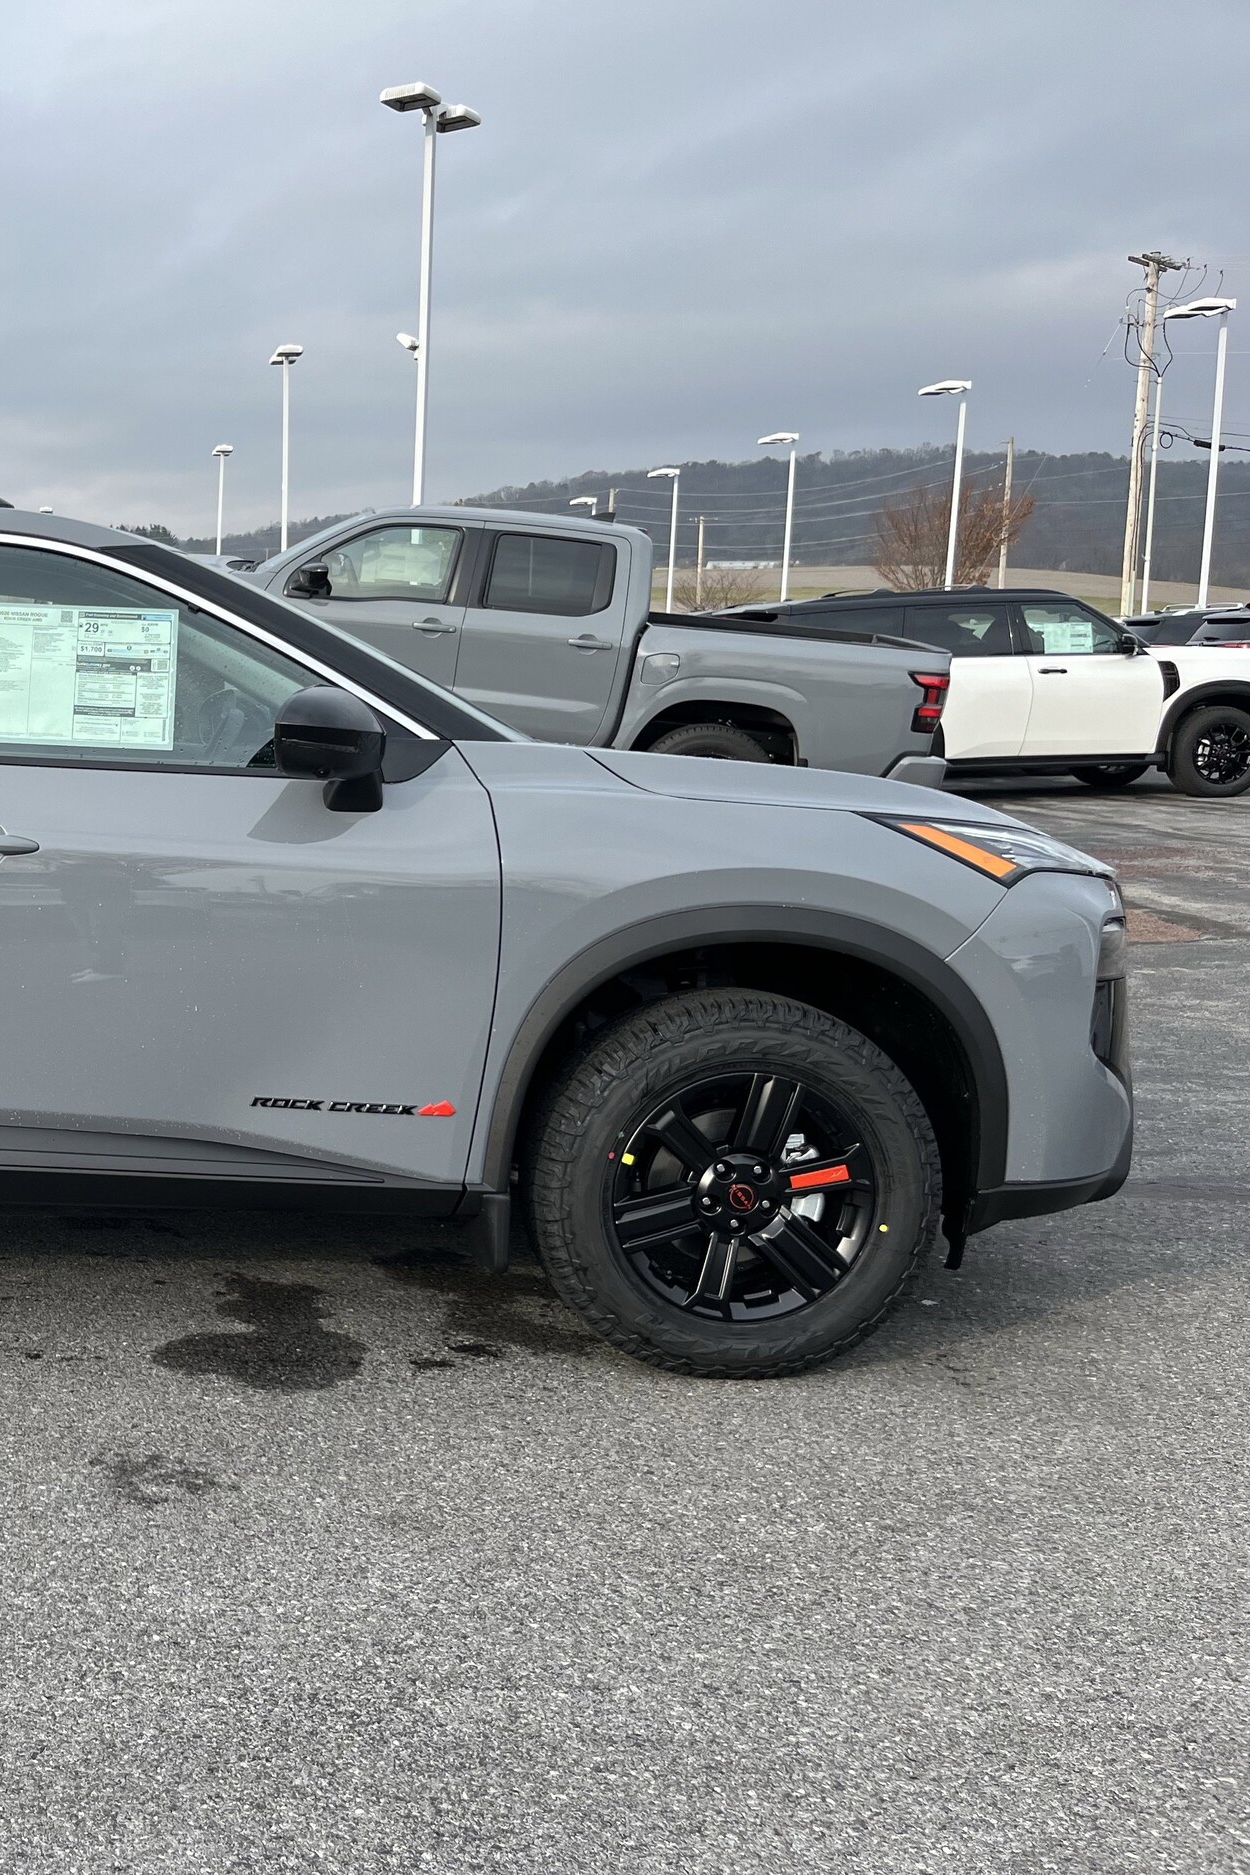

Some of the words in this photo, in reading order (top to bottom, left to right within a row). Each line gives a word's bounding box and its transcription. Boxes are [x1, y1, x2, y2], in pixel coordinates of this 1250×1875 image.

[84, 622, 99, 633] 29
[249, 1096, 325, 1111] ROCK
[327, 1100, 418, 1115] CREEK
